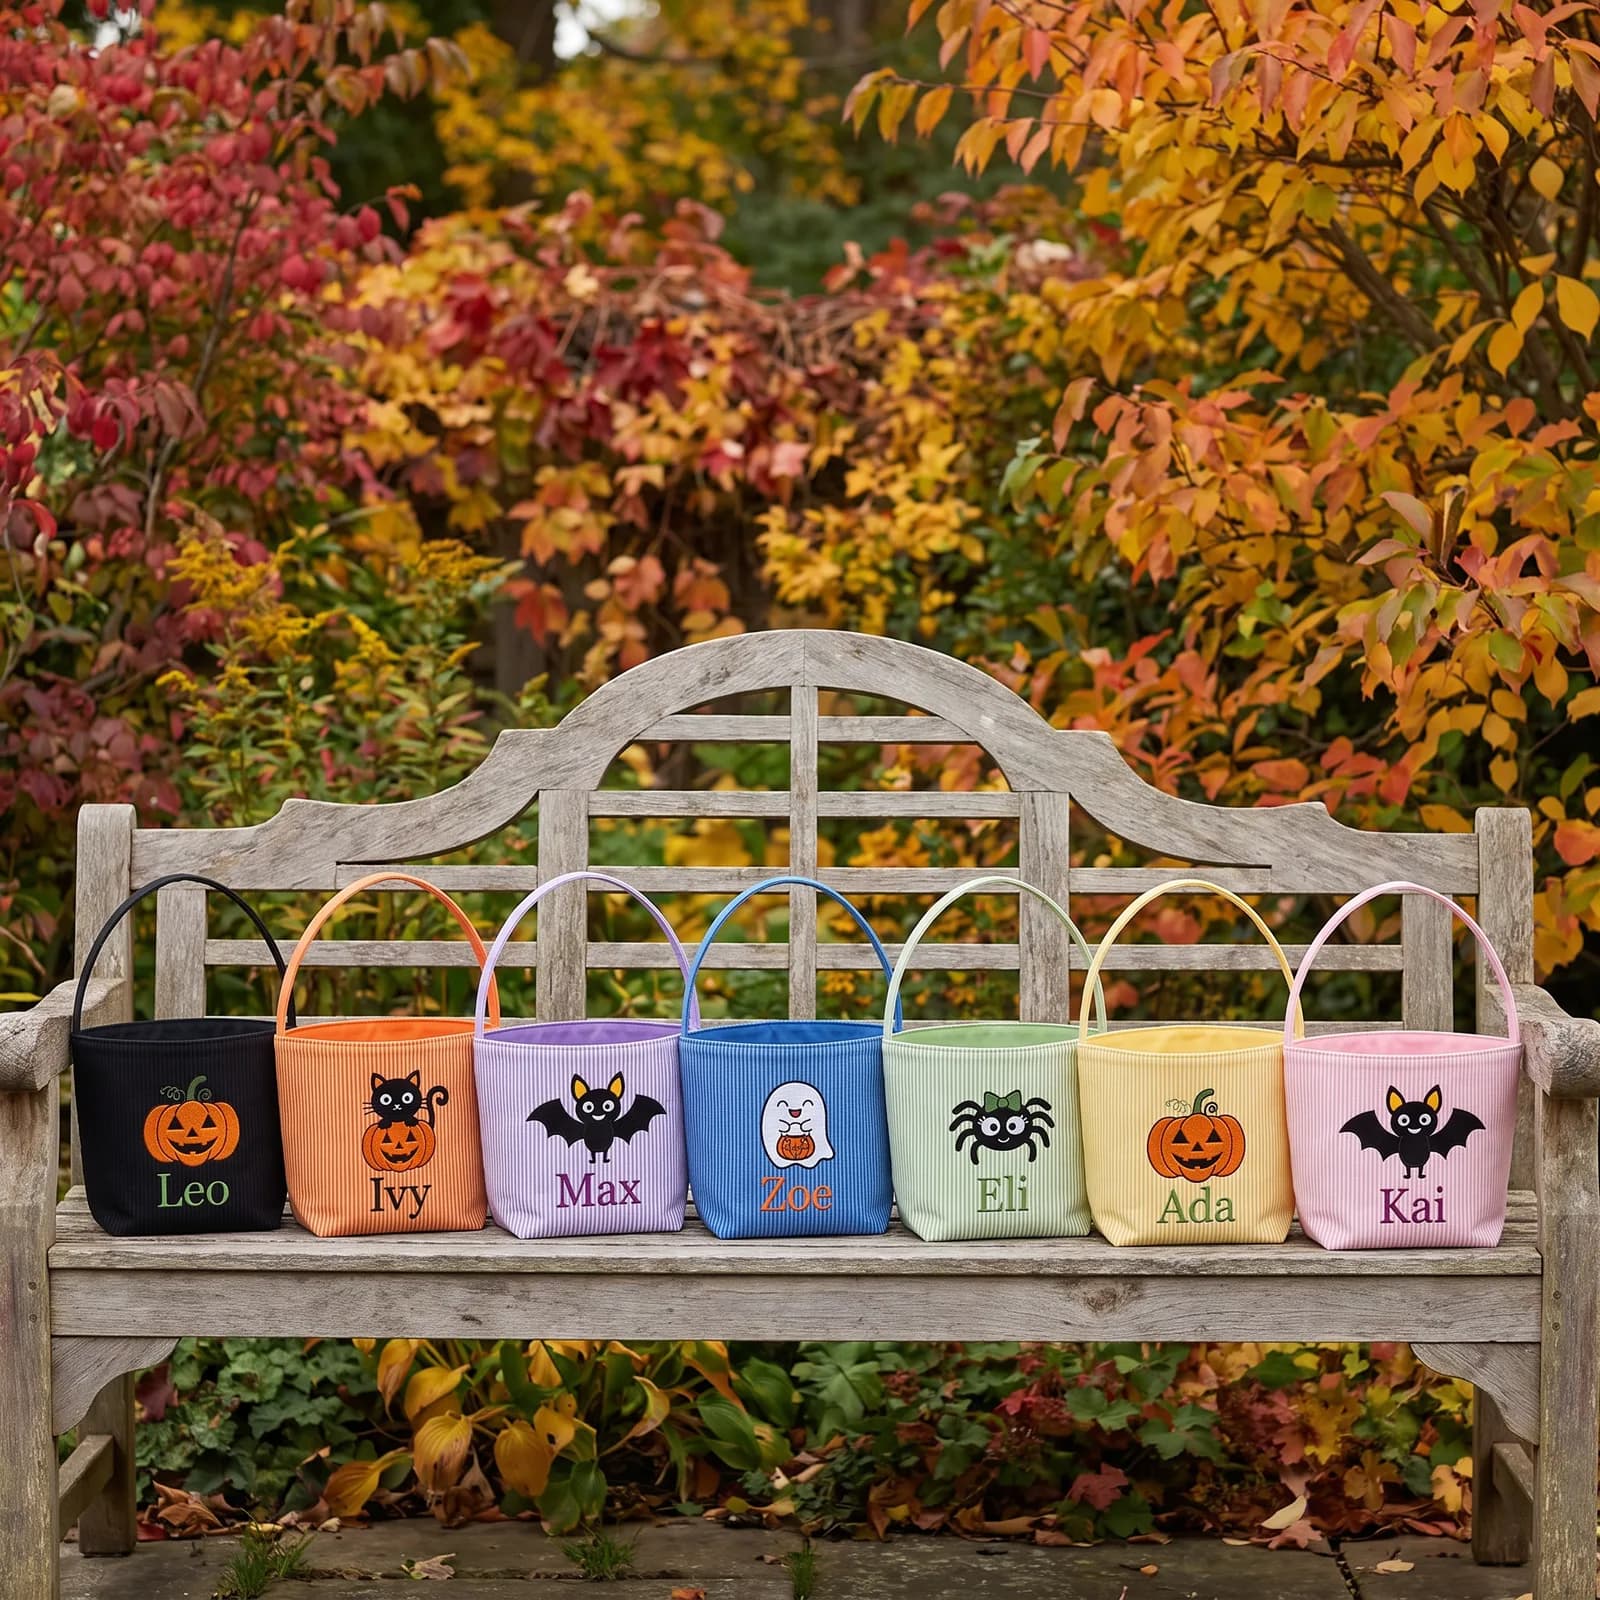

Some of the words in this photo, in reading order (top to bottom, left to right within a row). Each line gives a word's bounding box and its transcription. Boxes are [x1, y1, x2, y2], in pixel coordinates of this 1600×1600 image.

[157, 1173, 230, 1208] Leo
[370, 1177, 432, 1219] Ivy
[555, 1172, 642, 1208] Max
[759, 1176, 833, 1212] Zoe
[976, 1175, 1029, 1213] Eli
[1156, 1185, 1236, 1224] Ada
[1380, 1185, 1447, 1224] Kai
